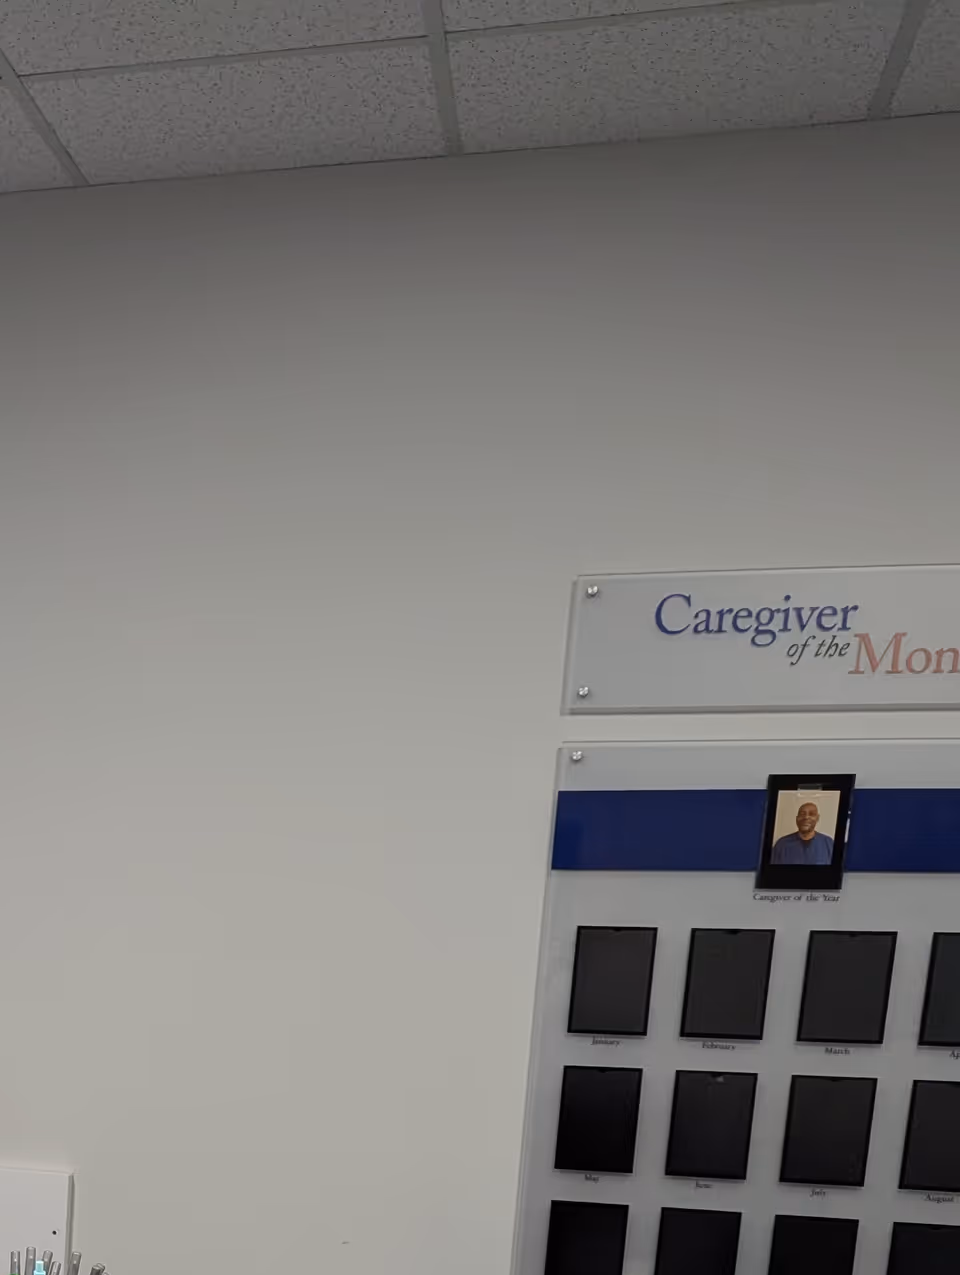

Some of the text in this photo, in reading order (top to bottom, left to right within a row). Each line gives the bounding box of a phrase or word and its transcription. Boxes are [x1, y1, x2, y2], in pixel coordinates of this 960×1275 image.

[654, 593, 859, 648] Caregiver
[786, 635, 850, 666] of the
